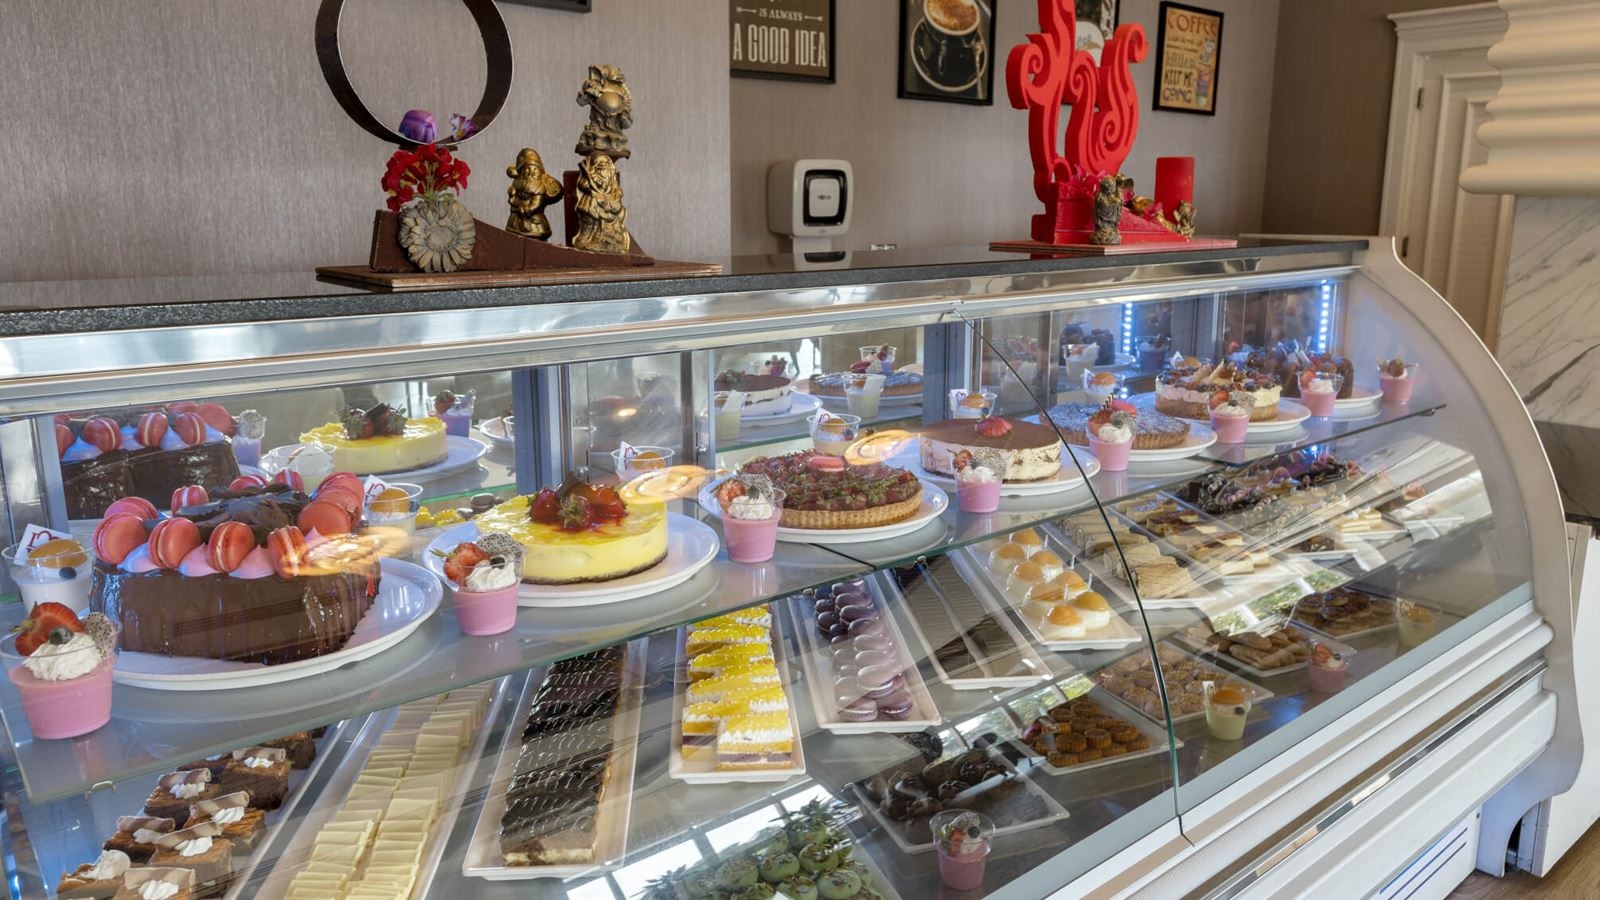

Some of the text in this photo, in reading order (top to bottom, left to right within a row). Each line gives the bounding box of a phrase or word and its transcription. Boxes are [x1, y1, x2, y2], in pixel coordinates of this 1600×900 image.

[759, 8, 802, 21] IS ALWAYS
[1167, 10, 1217, 37] COFFEE
[733, 23, 826, 67] A GOOD IDEA
